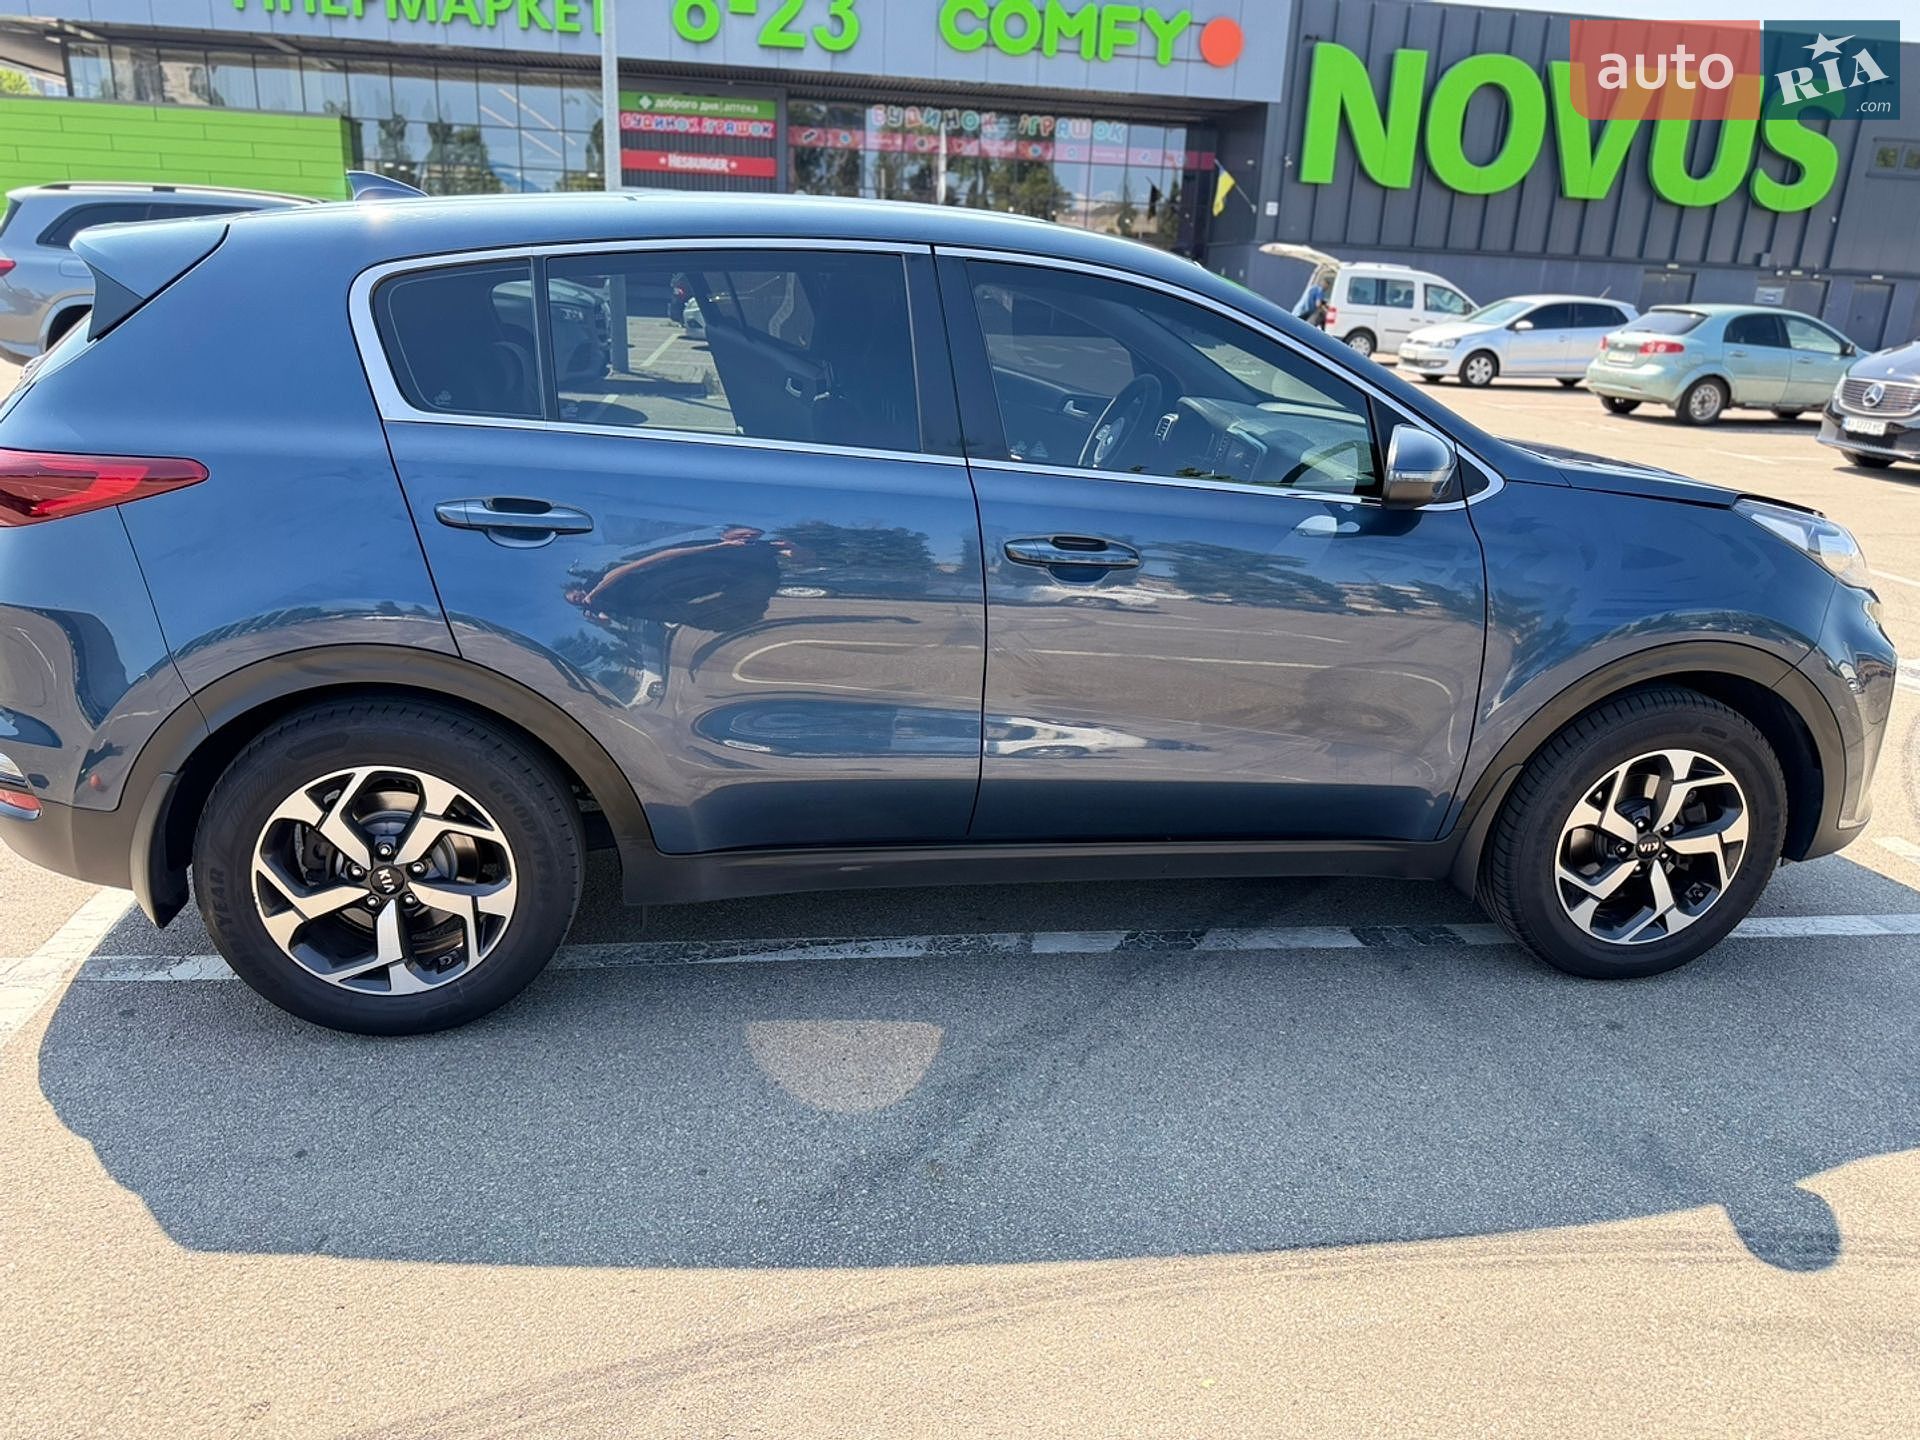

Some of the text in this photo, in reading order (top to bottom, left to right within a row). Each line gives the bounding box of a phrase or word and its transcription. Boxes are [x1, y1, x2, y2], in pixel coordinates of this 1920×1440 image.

[940, 0, 1192, 66] COMFY
[871, 103, 998, 133] БУДИНОК
[1299, 43, 1848, 215] NOVUS
[1638, 842, 1660, 853] KIA
[377, 868, 396, 893] KIA
